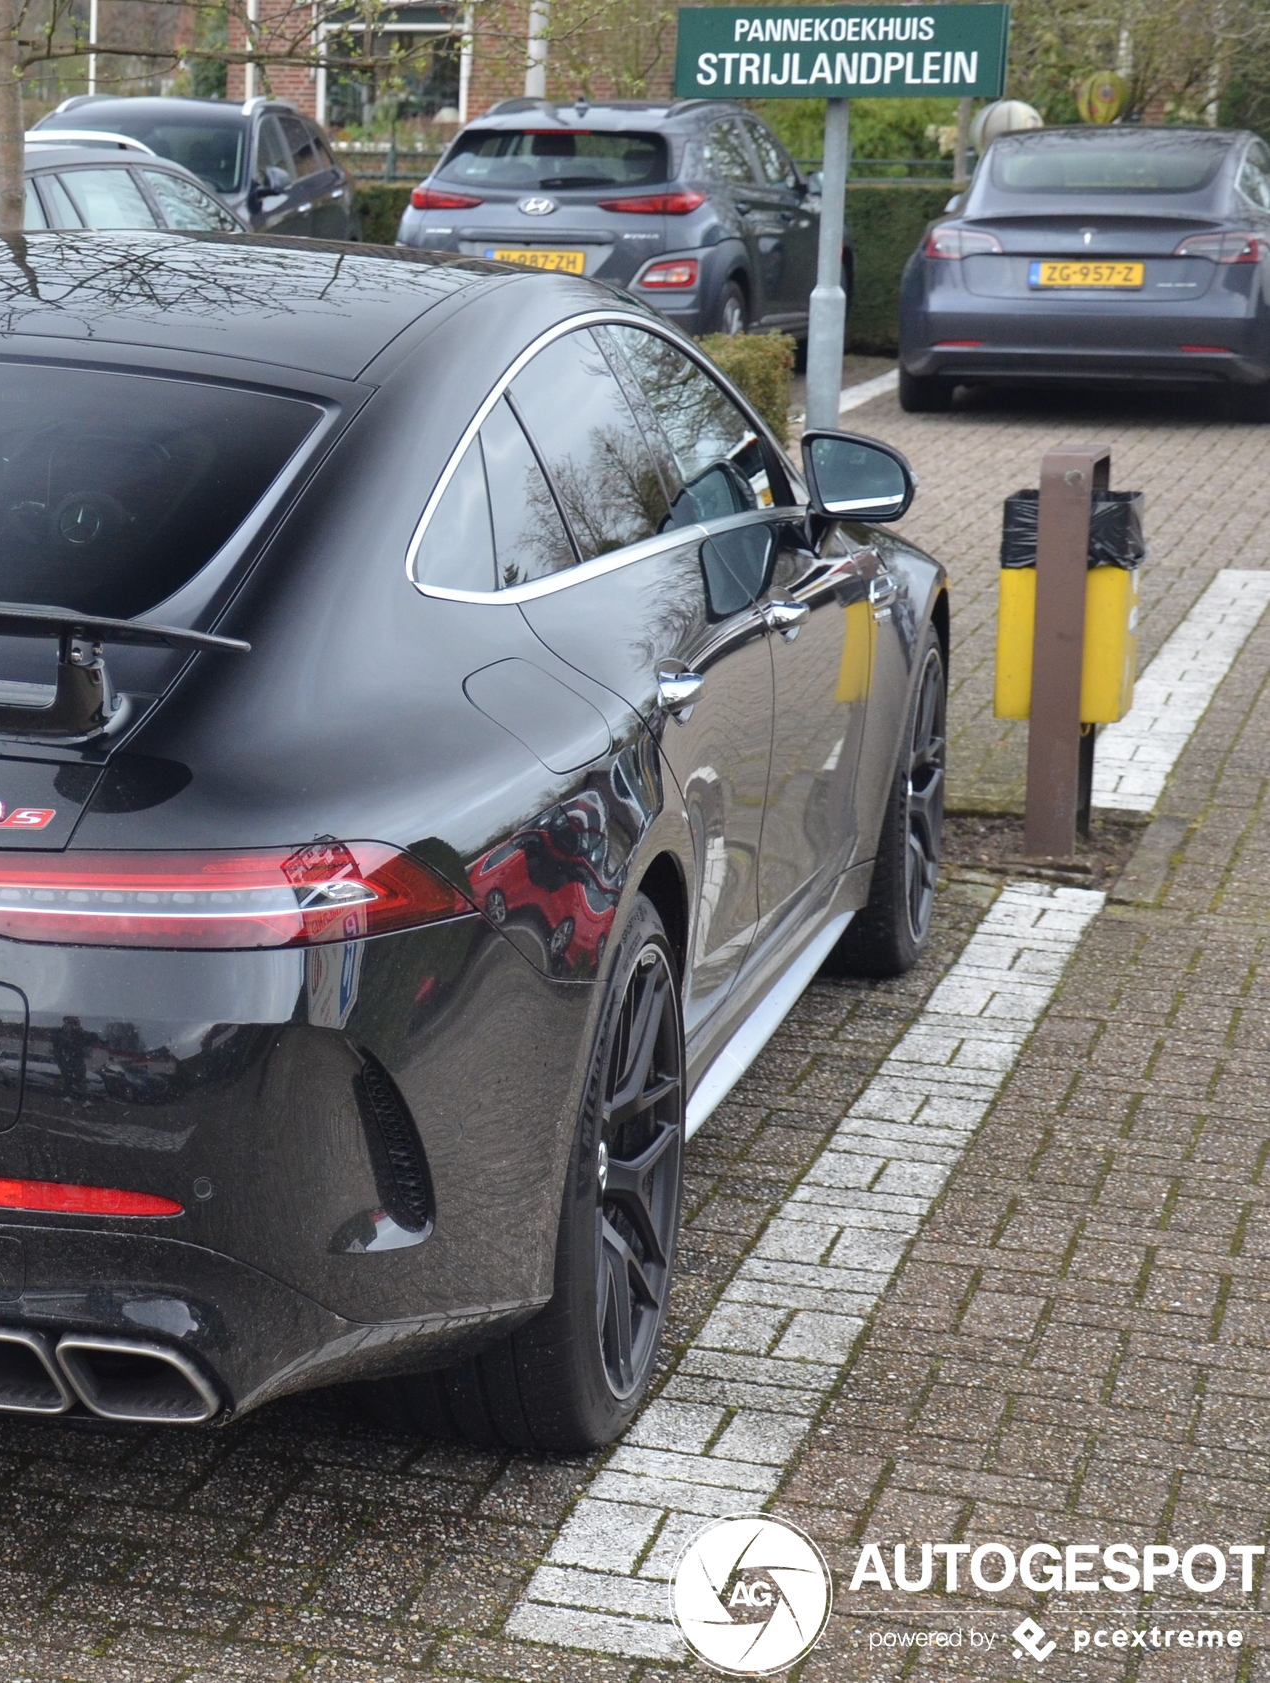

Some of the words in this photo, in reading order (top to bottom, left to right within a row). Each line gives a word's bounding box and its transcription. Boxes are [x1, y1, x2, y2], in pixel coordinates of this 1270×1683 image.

[734, 16, 935, 42] PANNEKOEKHUIS
[696, 51, 978, 85] STRIJLANDPLEIN
[1047, 265, 1134, 282] ZG-957-Z
